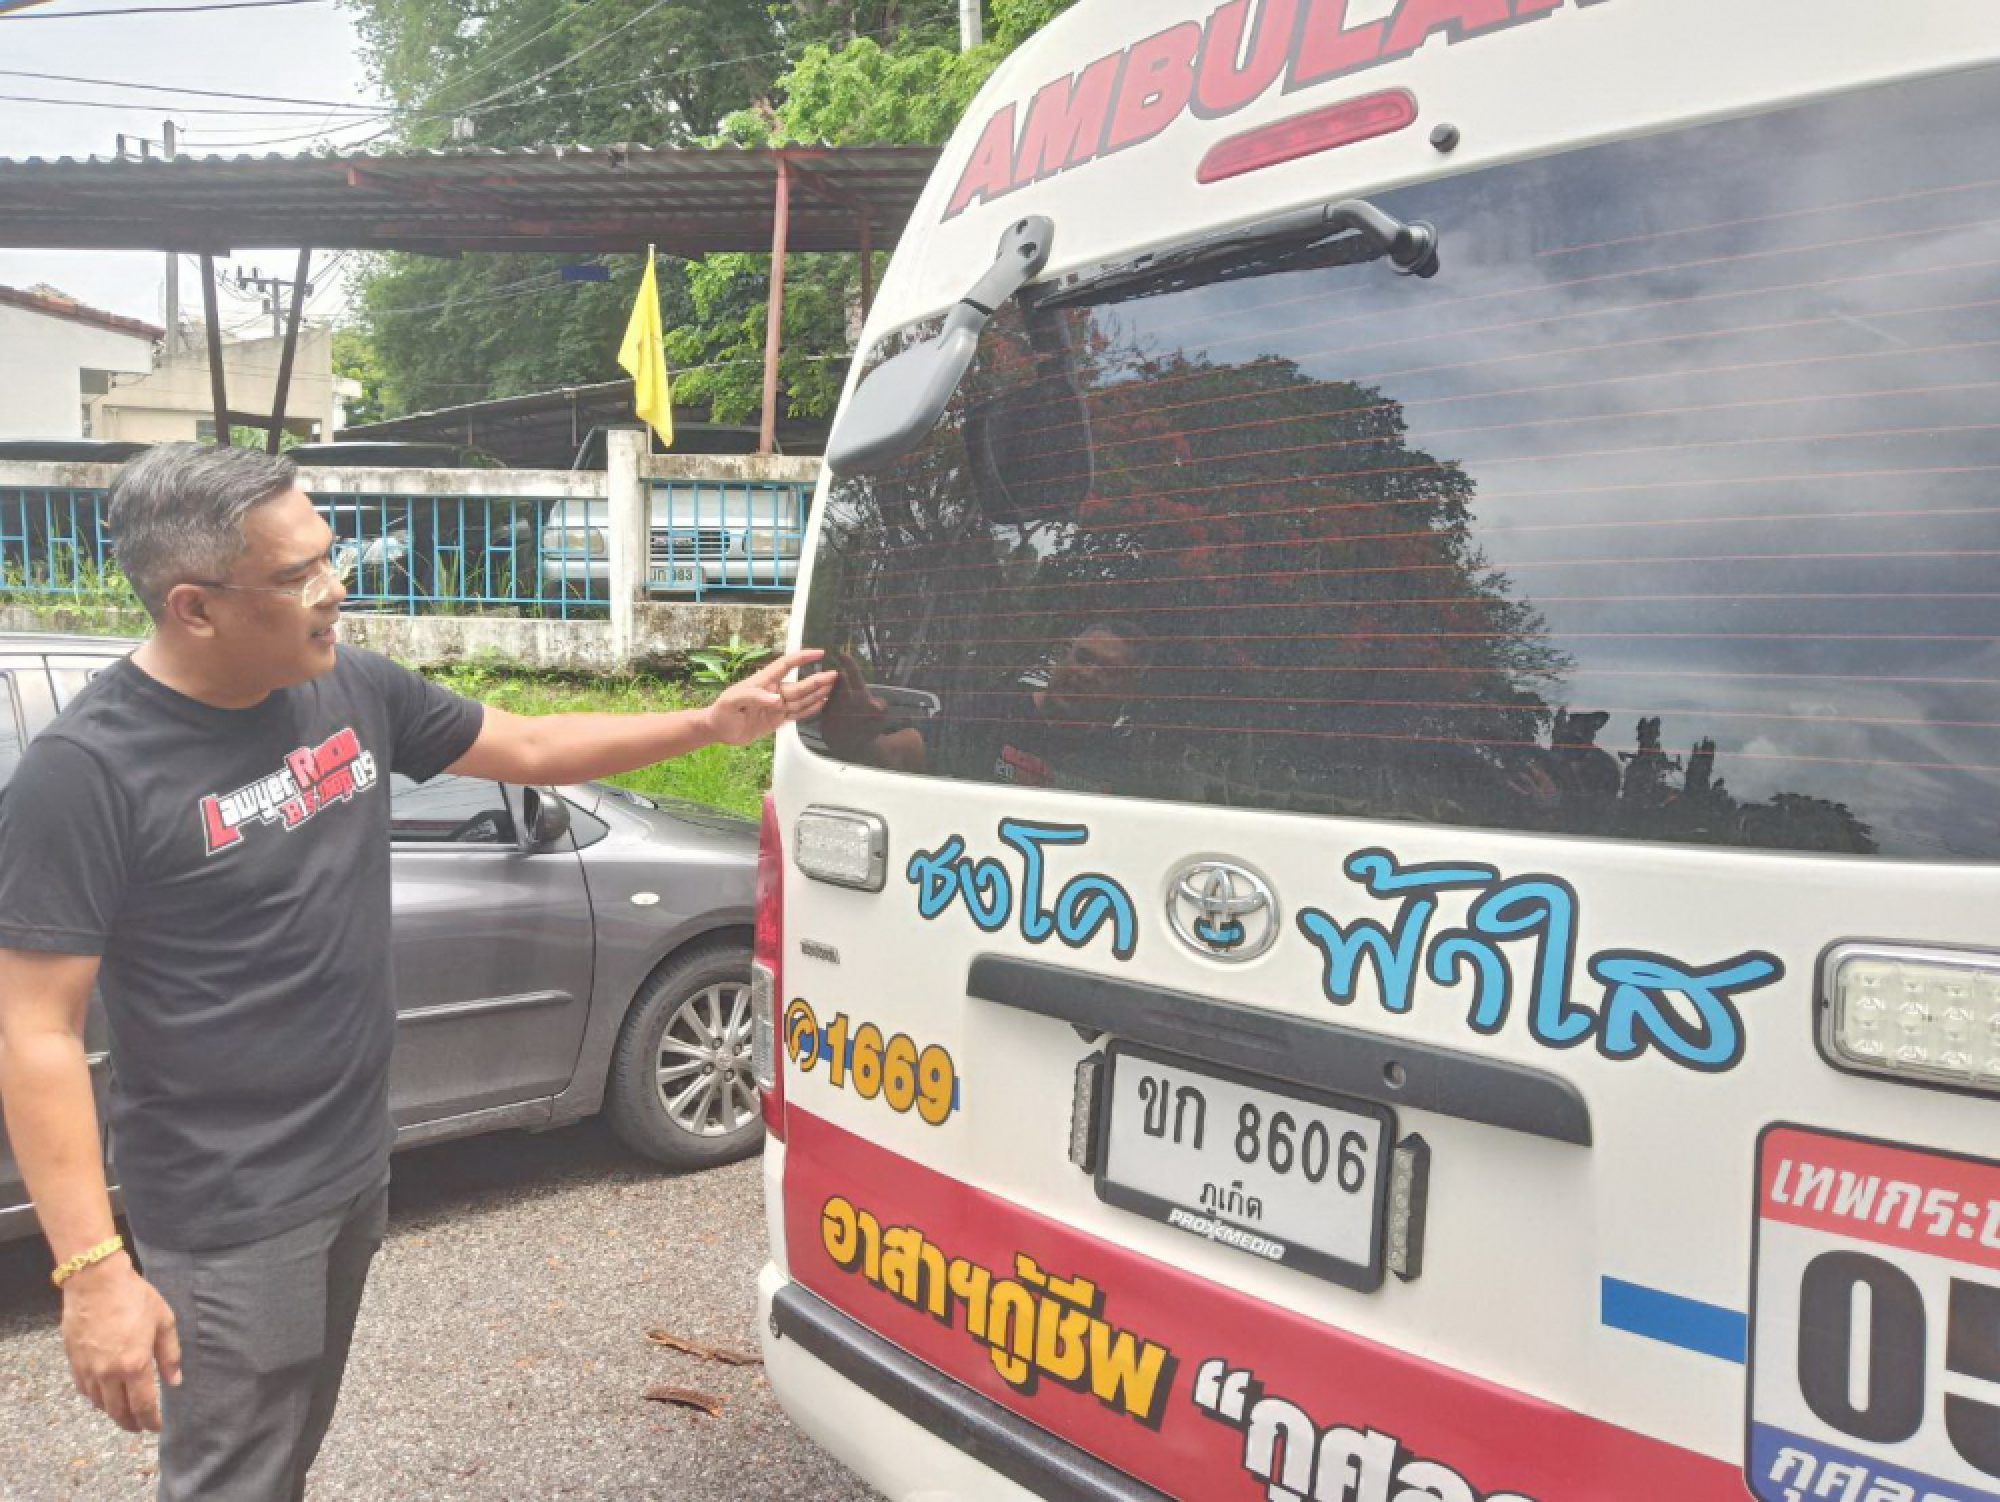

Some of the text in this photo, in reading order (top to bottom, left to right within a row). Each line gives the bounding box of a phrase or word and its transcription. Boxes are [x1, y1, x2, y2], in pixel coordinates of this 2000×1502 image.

[941, 0, 1610, 222] AMBUL
[200, 768, 298, 856] Lawyer
[906, 816, 1785, 1073] ชงโค ฟ้าใส
[826, 1011, 955, 1127] 1669
[1234, 1102, 1369, 1194] 8606
